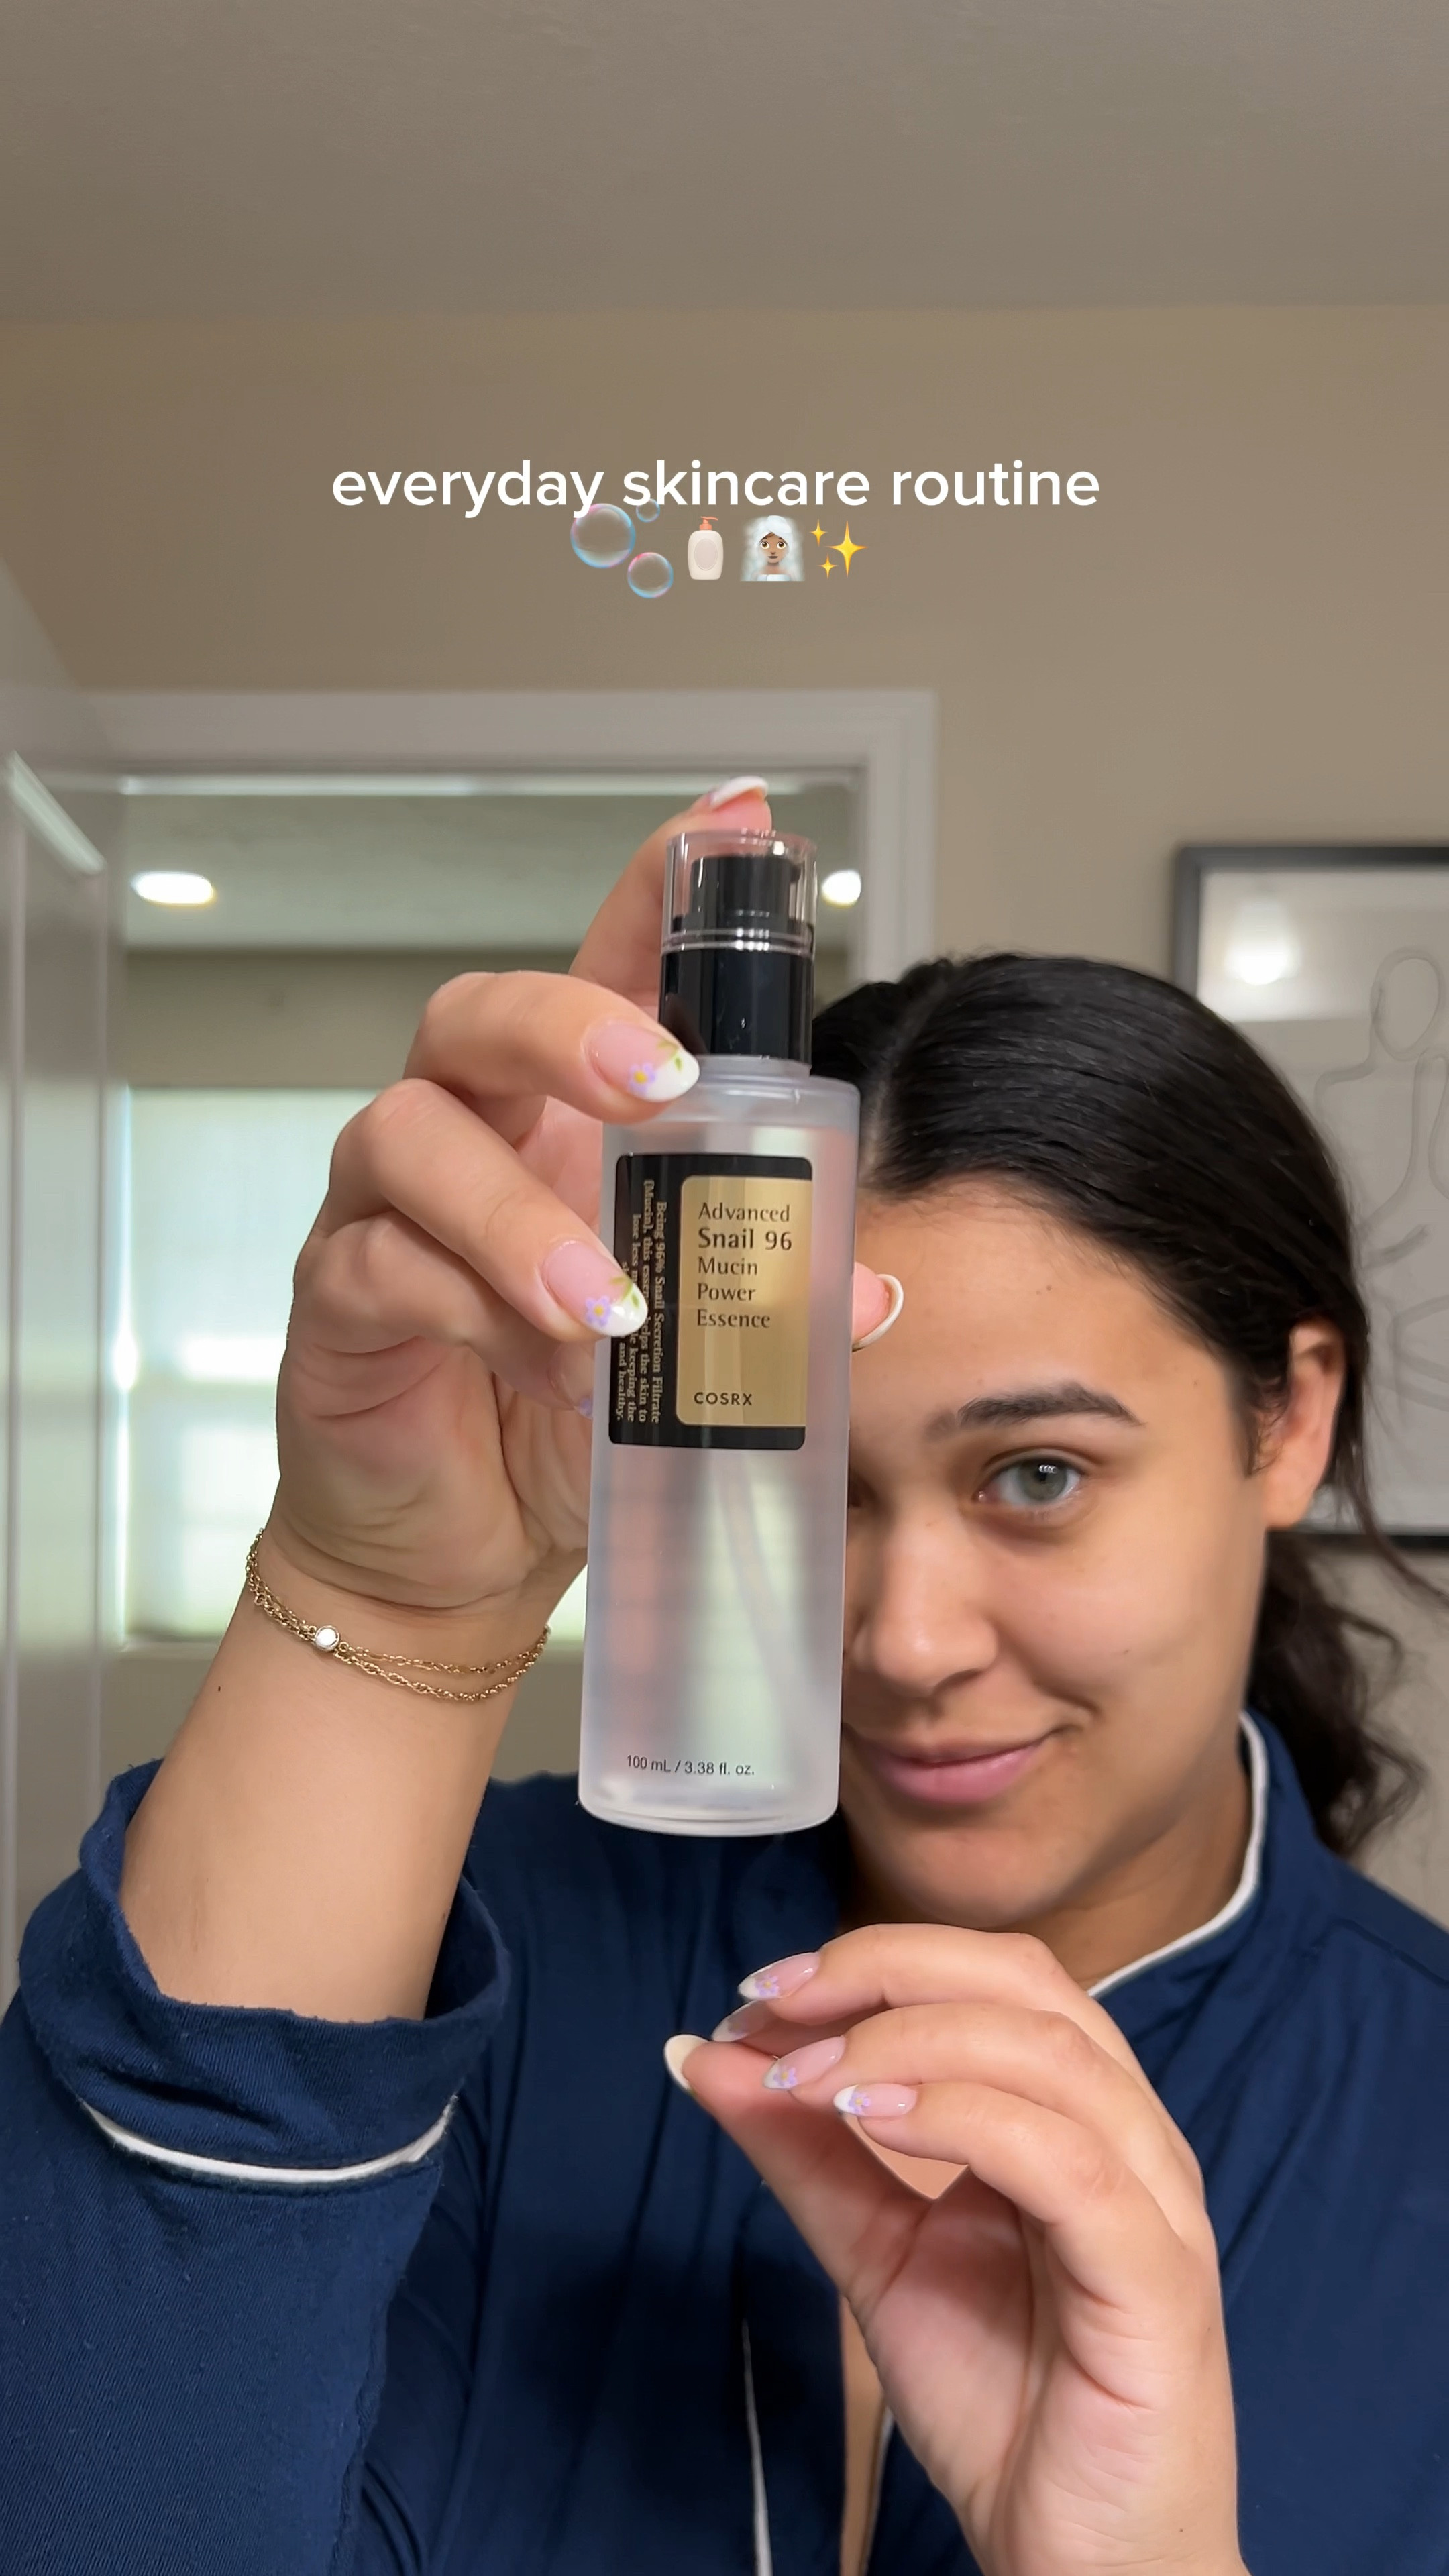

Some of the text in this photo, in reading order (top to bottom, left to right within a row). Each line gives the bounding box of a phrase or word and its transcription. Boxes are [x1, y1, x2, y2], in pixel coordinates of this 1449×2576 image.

[698, 1202, 790, 1223] Advanced
[632, 1214, 642, 1240] lose
[643, 1237, 653, 1261] this
[698, 1226, 792, 1251] Snail 96
[632, 1242, 641, 1267] less
[698, 1256, 758, 1275] Mucin
[697, 1282, 756, 1301] Power
[651, 1201, 667, 1423] Being 96% Snail Secretion Filtrate
[697, 1308, 771, 1328] Essence
[627, 1348, 638, 1397] keeping
[640, 1354, 650, 1374] the
[616, 1343, 627, 1421] and healthy.
[640, 1377, 649, 1405] skin
[694, 1391, 753, 1406] COSRX
[627, 1401, 637, 1421] the
[639, 1409, 647, 1422] to
[627, 1755, 755, 1776] 100 mL / 3.38 fl. oz.
